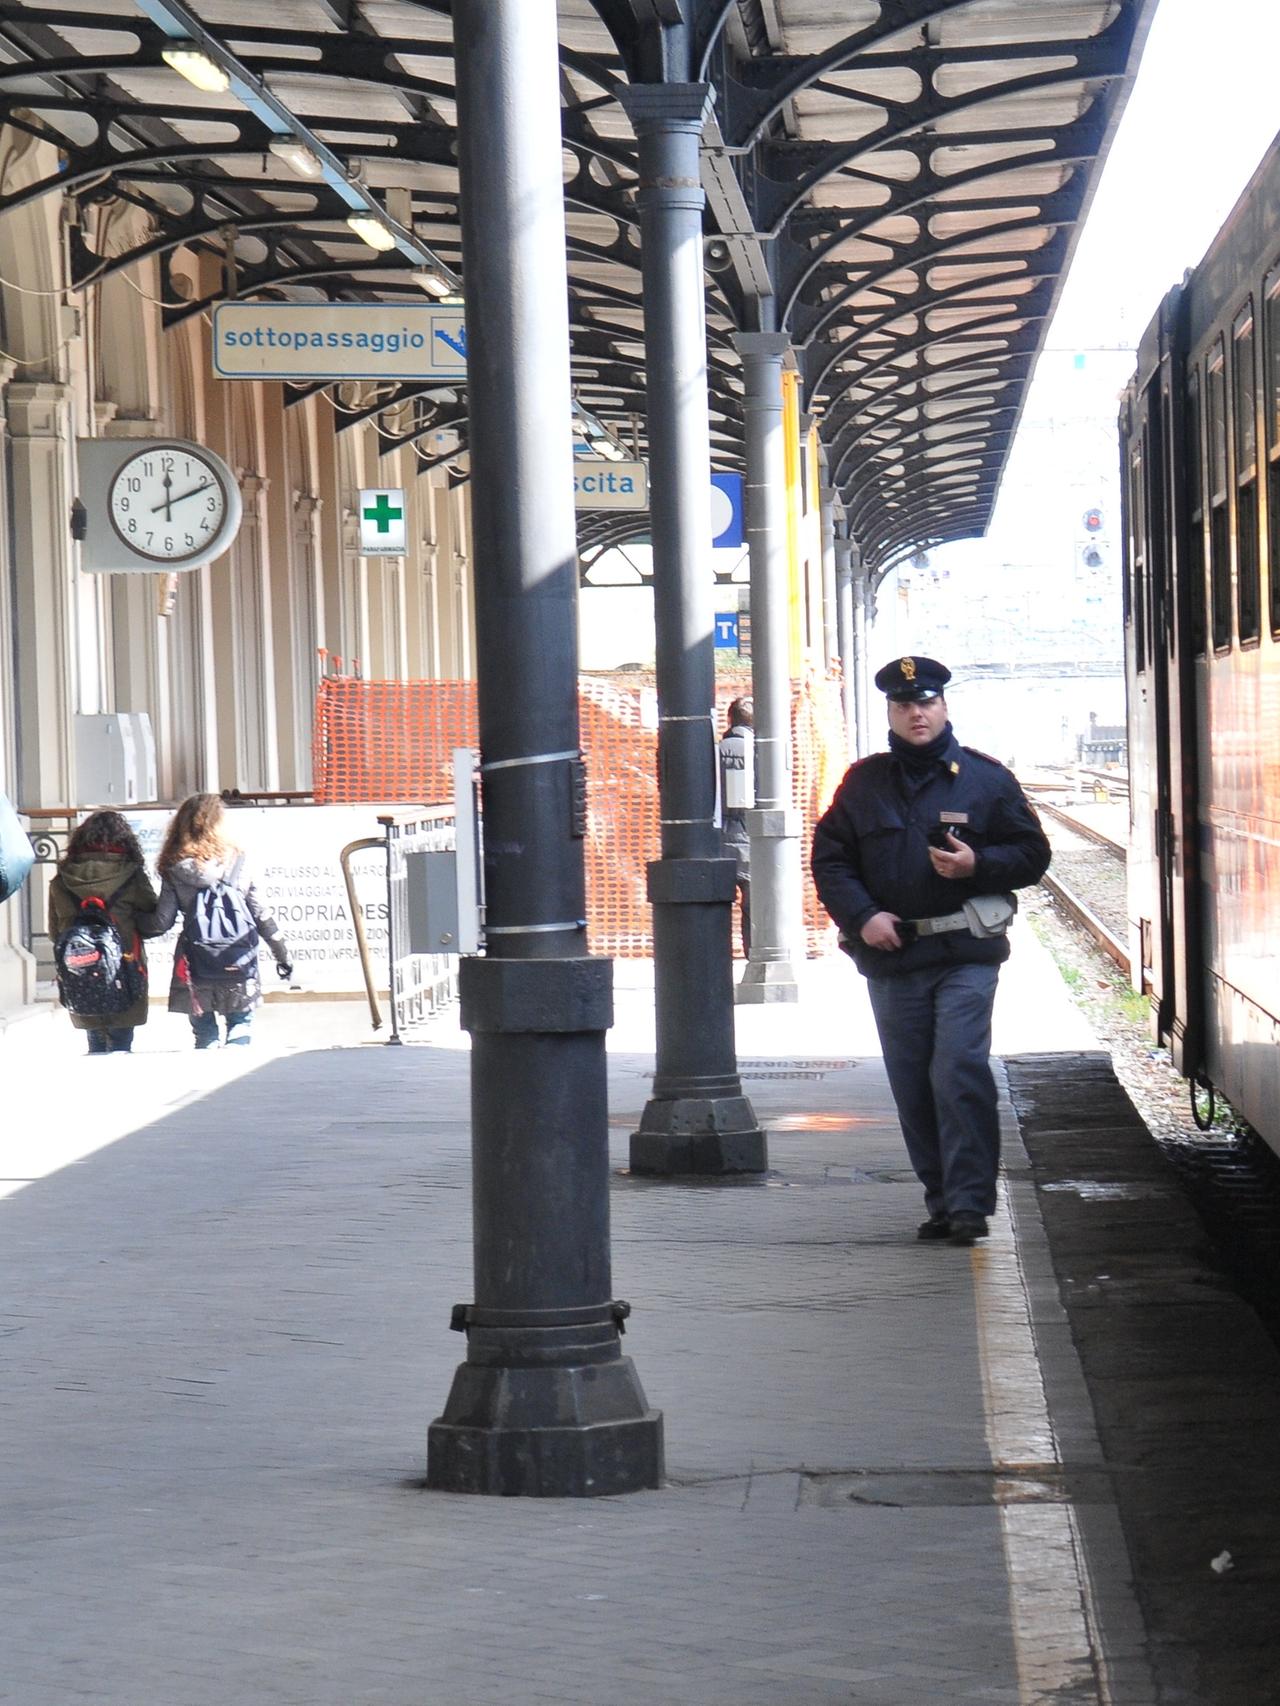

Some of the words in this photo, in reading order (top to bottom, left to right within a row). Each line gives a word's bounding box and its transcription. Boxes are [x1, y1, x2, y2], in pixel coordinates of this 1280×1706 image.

[224, 327, 424, 352] sottopassaggio
[144, 462, 153, 477] 11
[161, 458, 174, 472] 12
[127, 478, 141, 492] 10
[121, 497, 130, 512] 9
[207, 497, 216, 512] 3
[128, 518, 137, 533] 8
[200, 517, 209, 531] 4
[145, 532, 154, 546] 7
[164, 537, 173, 551] 6
[185, 533, 194, 547] 5
[264, 866, 320, 878] AFFLUSSO
